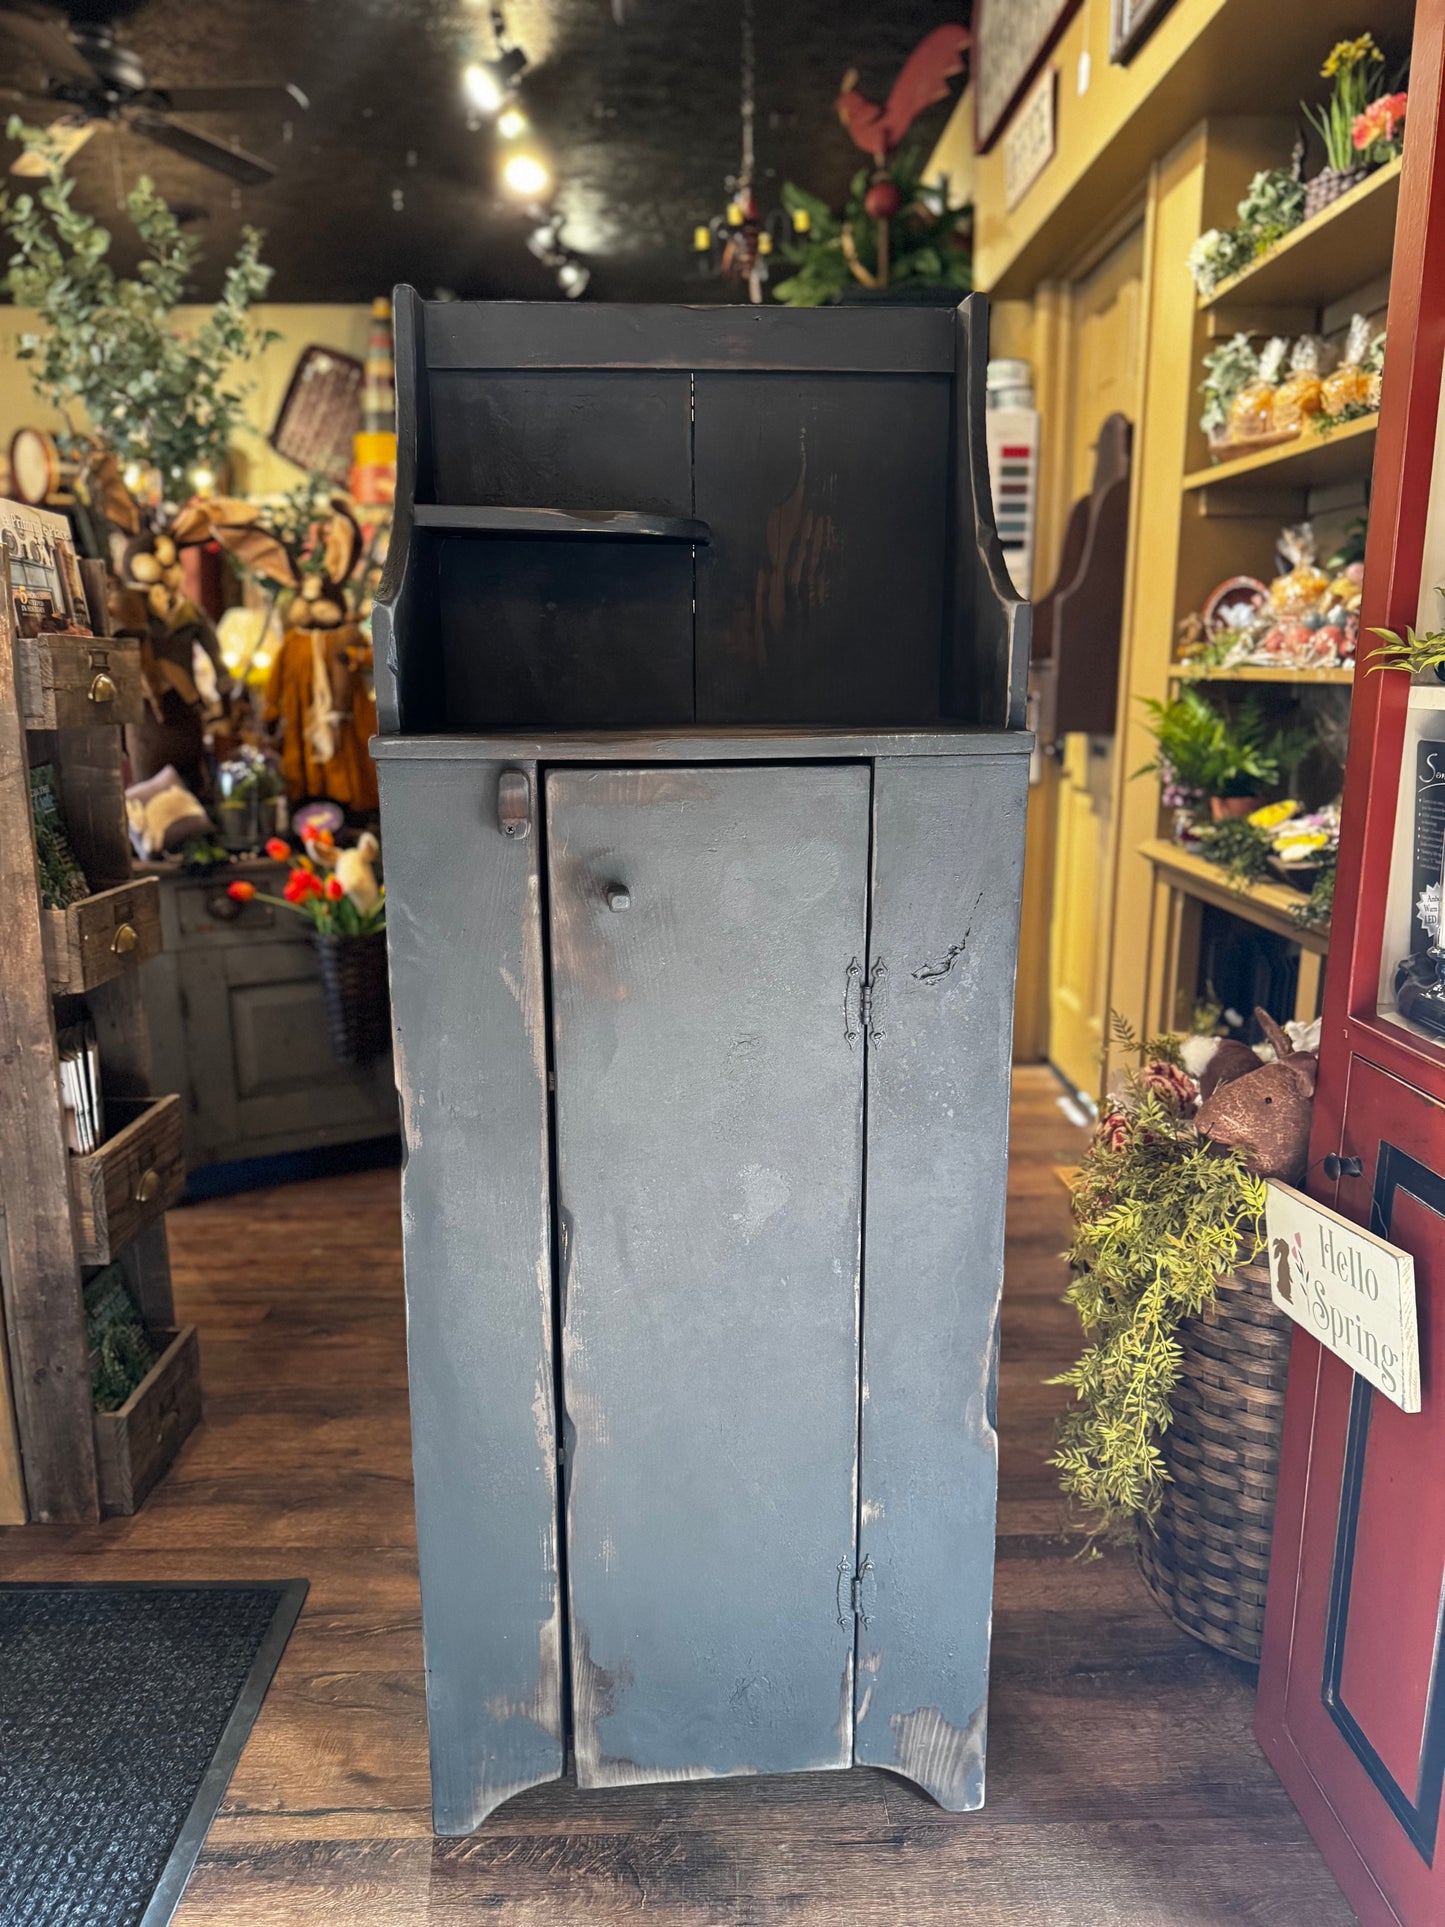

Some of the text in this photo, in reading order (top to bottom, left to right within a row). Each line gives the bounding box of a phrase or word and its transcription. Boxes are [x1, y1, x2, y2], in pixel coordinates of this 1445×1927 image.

[1424, 915, 1436, 924] LED
[1318, 1223, 1379, 1302] Hello
[1311, 1279, 1399, 1394] Spring
